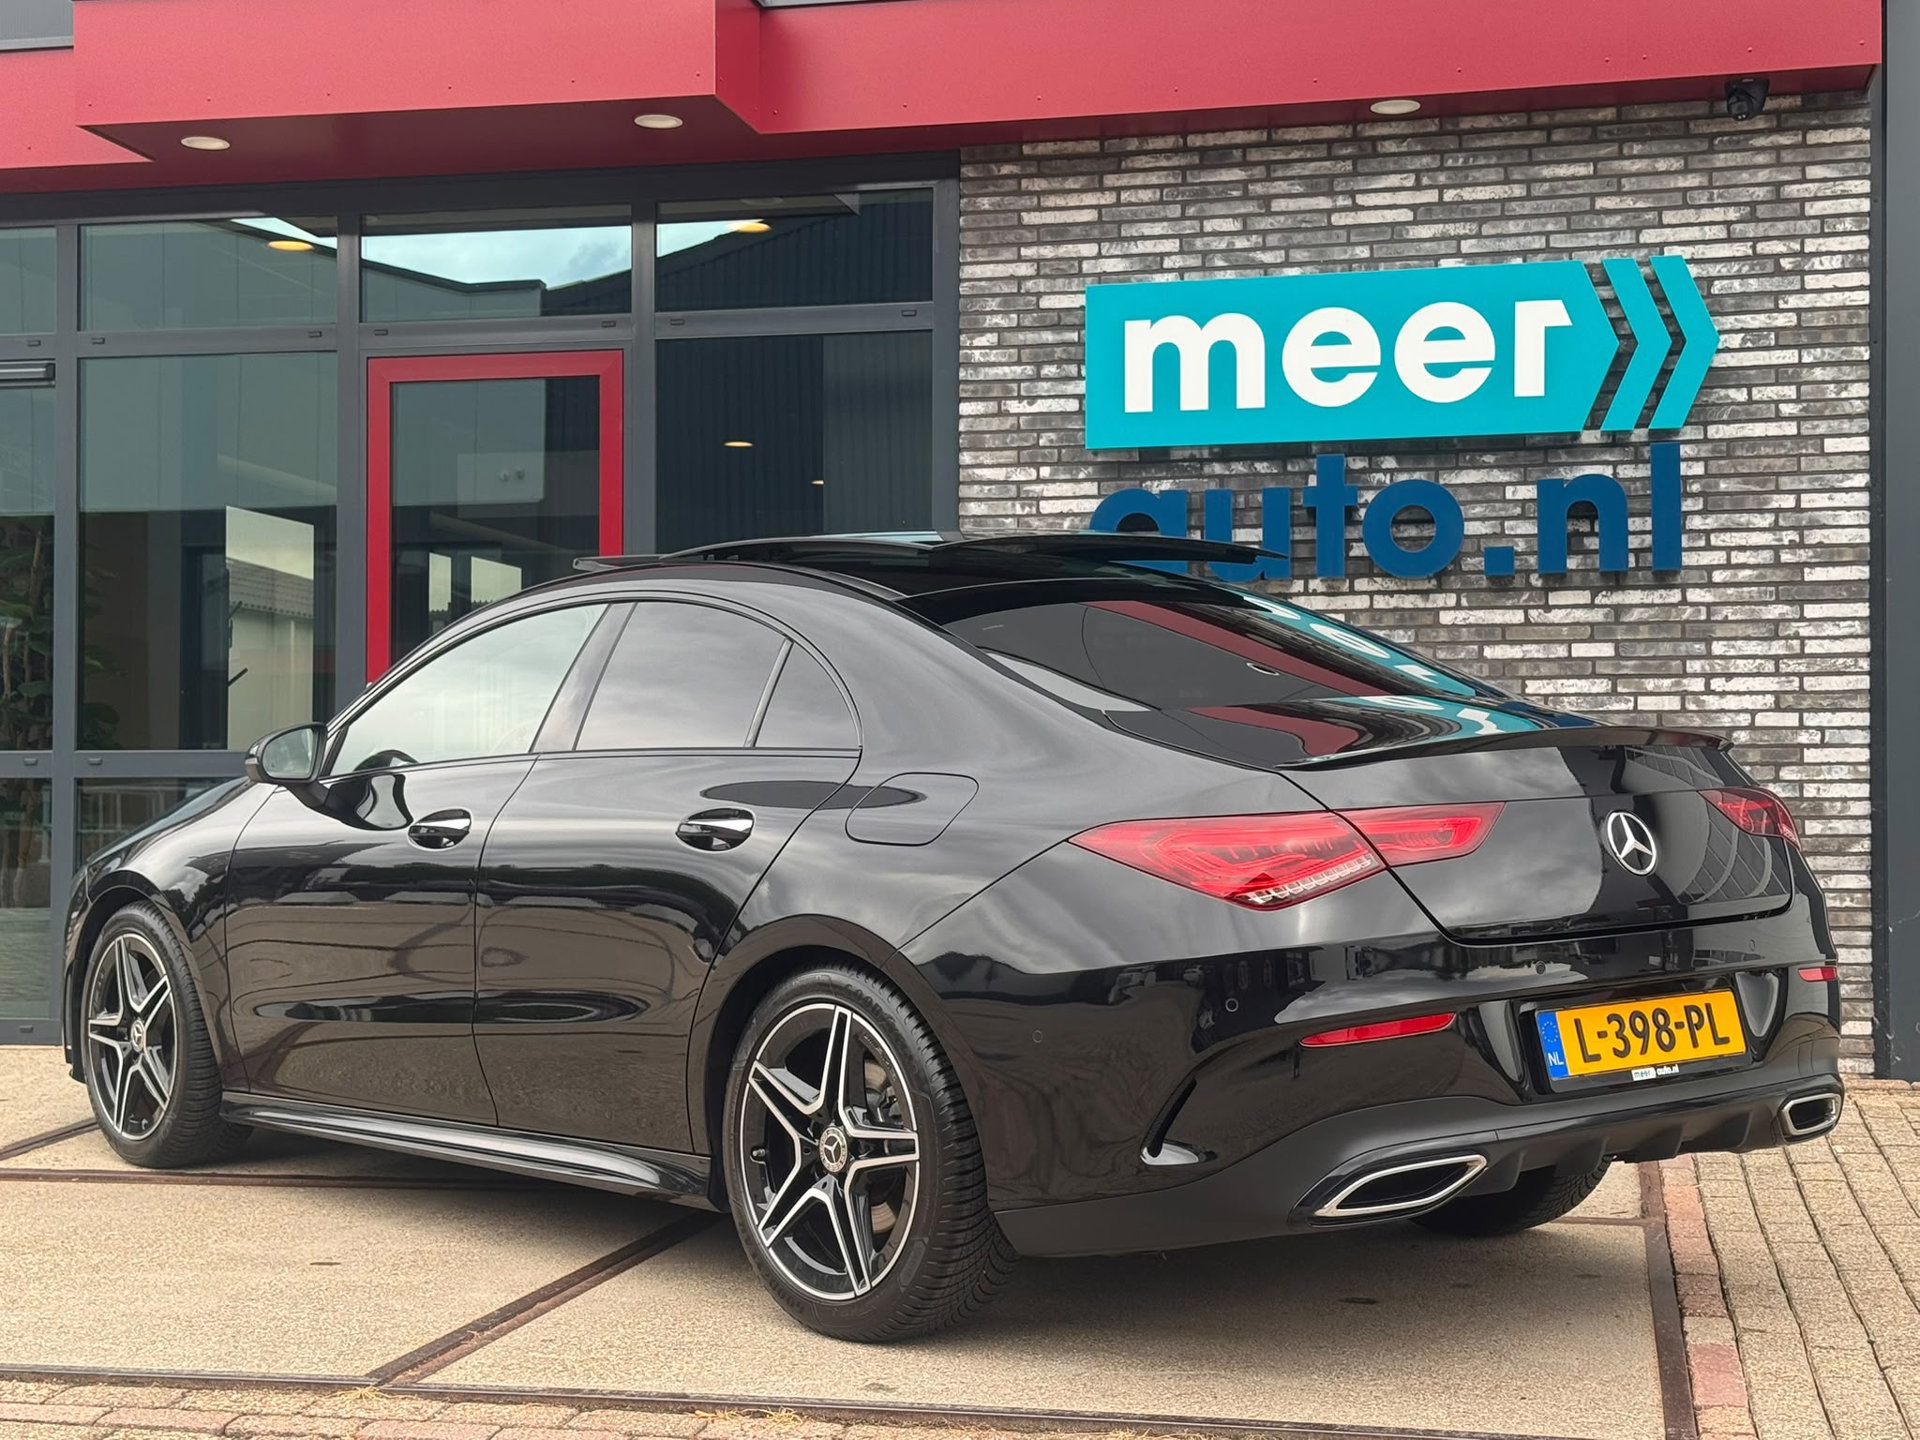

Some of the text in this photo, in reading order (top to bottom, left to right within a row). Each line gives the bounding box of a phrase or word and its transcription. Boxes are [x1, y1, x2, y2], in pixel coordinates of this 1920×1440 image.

[1124, 299, 1573, 413] meer
[1089, 443, 1681, 581] auto.nl
[1547, 1051, 1564, 1067] NL
[1574, 1003, 1730, 1063] L-398-PL
